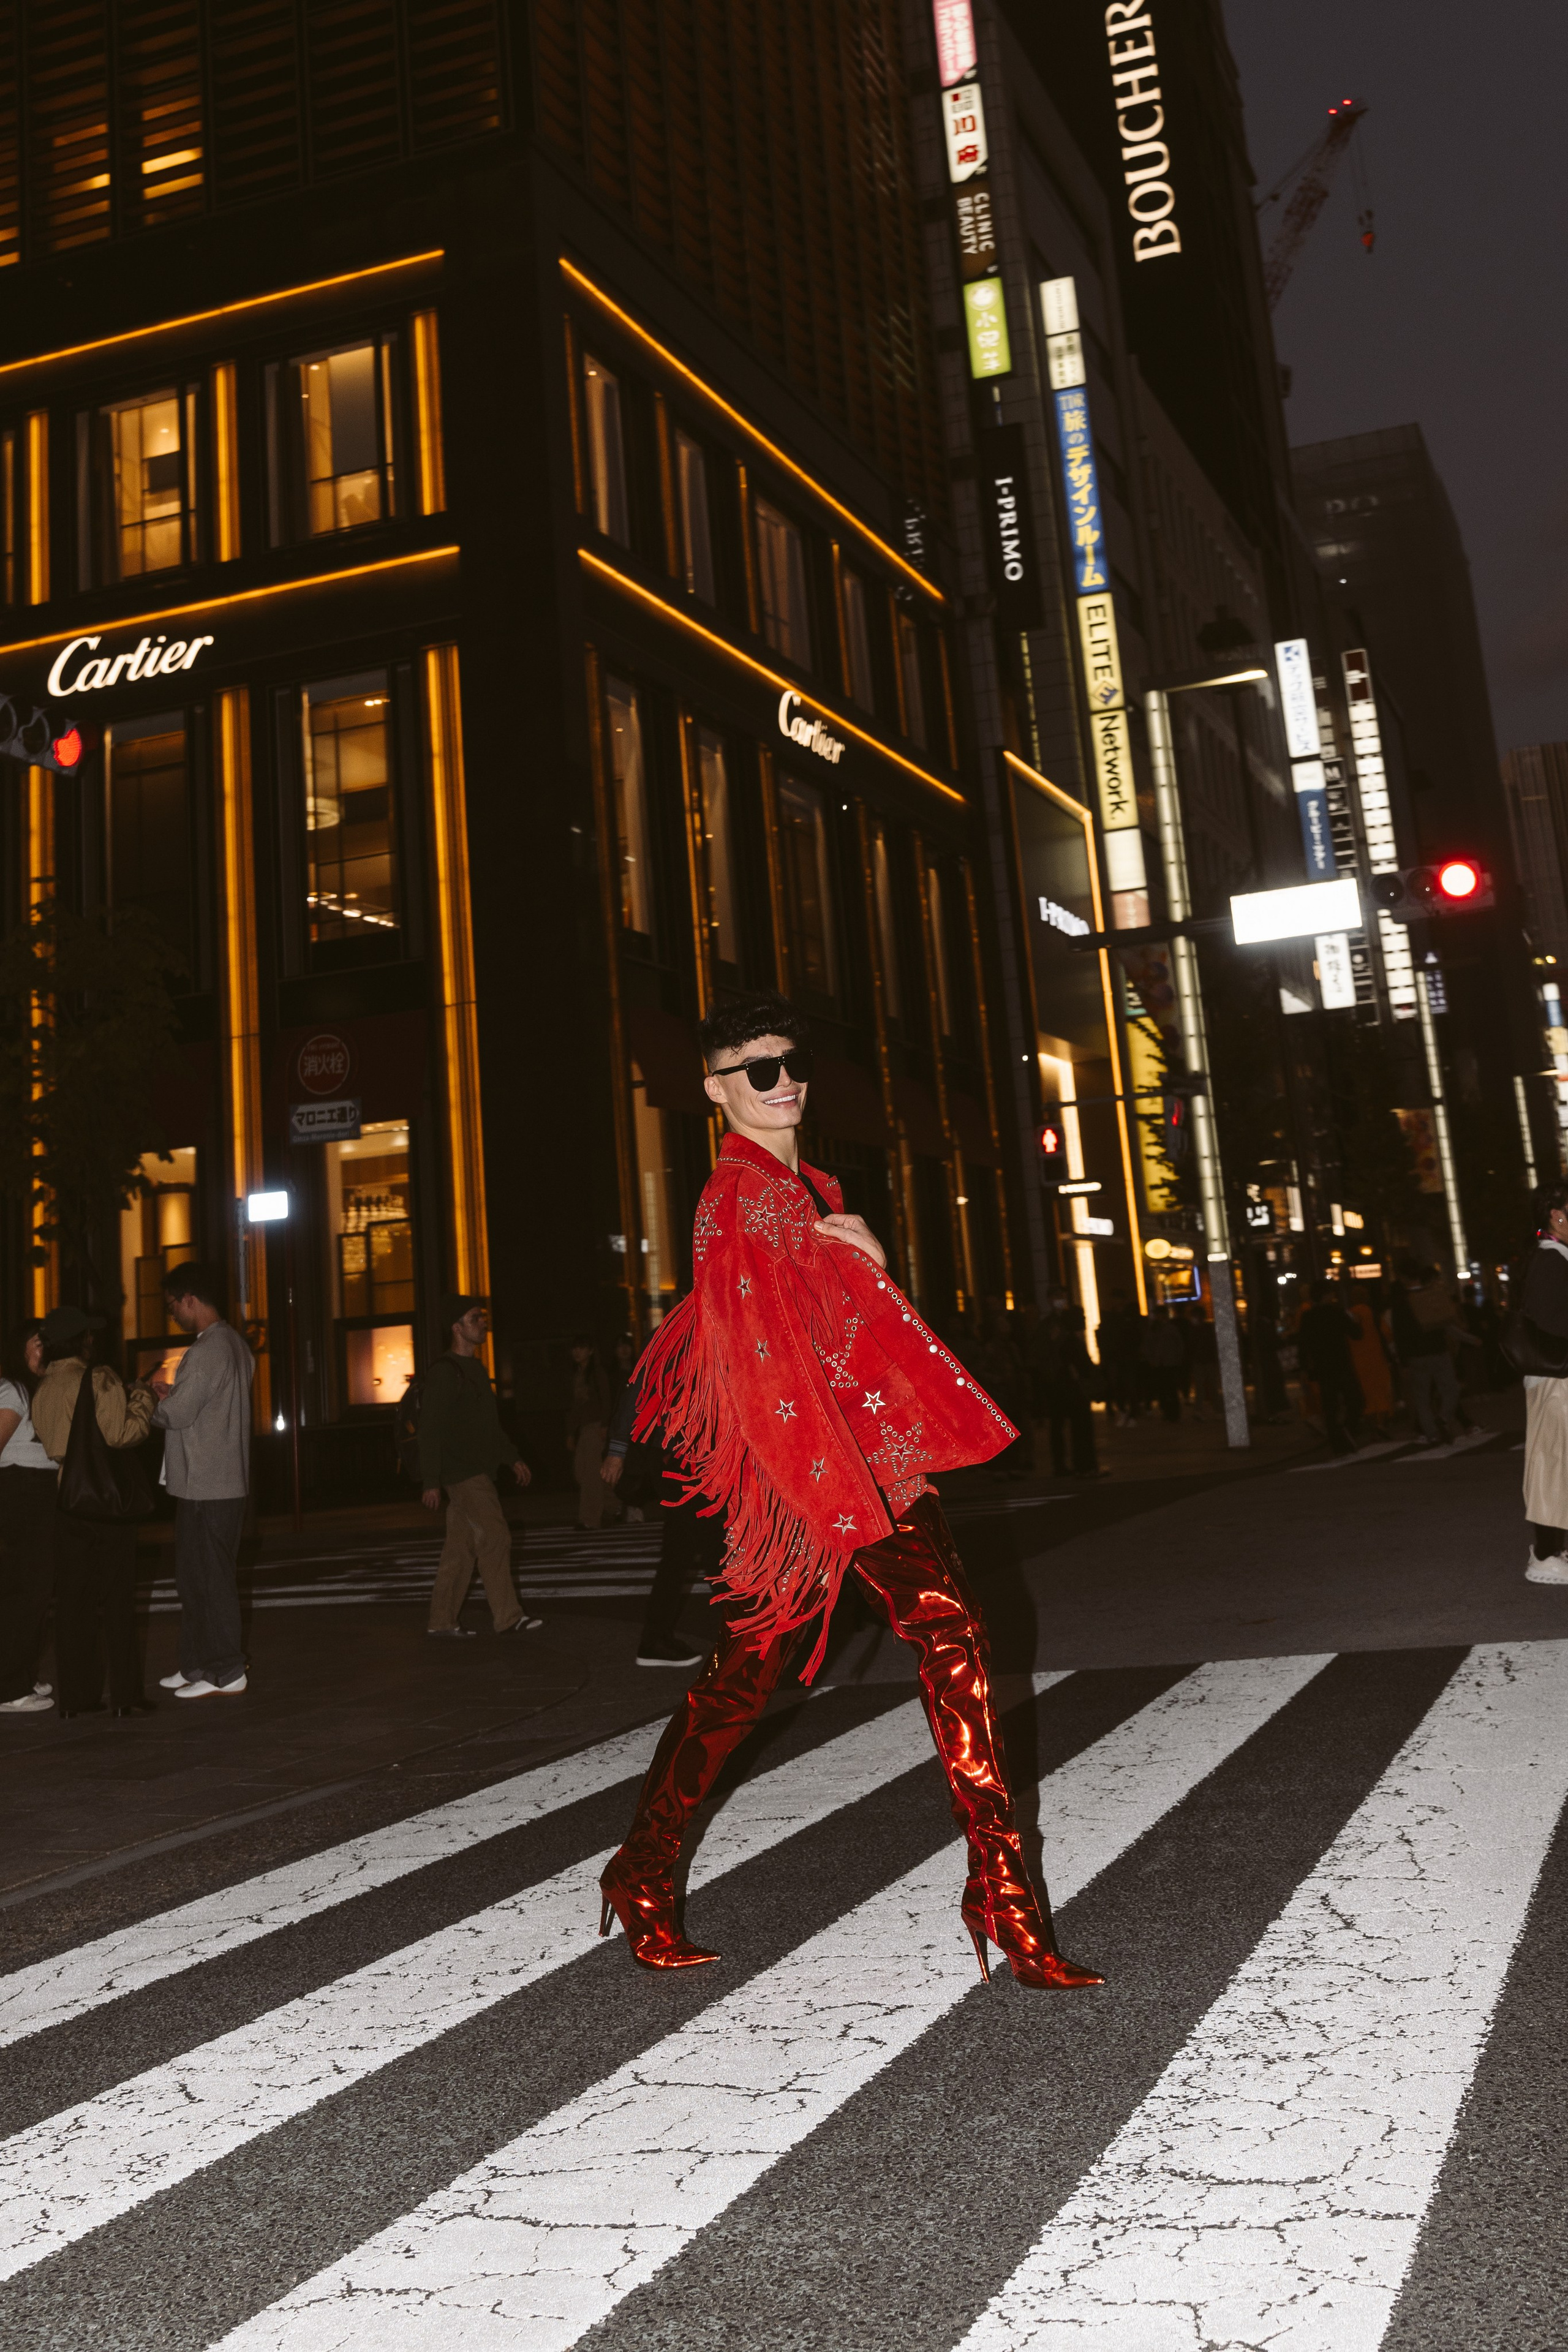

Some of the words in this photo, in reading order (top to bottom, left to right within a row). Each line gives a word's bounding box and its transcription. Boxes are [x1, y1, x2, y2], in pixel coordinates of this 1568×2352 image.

[1105, 0, 1181, 262] BOUCHER
[957, 197, 979, 254] BEAUTY
[973, 192, 995, 252] CLINIC
[995, 477, 1024, 581] I-PRIMO
[47, 635, 214, 697] Cartier
[1087, 604, 1114, 681] ELITE
[778, 690, 845, 764] Cartier
[304, 1052, 345, 1077] 消火栓
[296, 1106, 357, 1126] マロニエ通り
